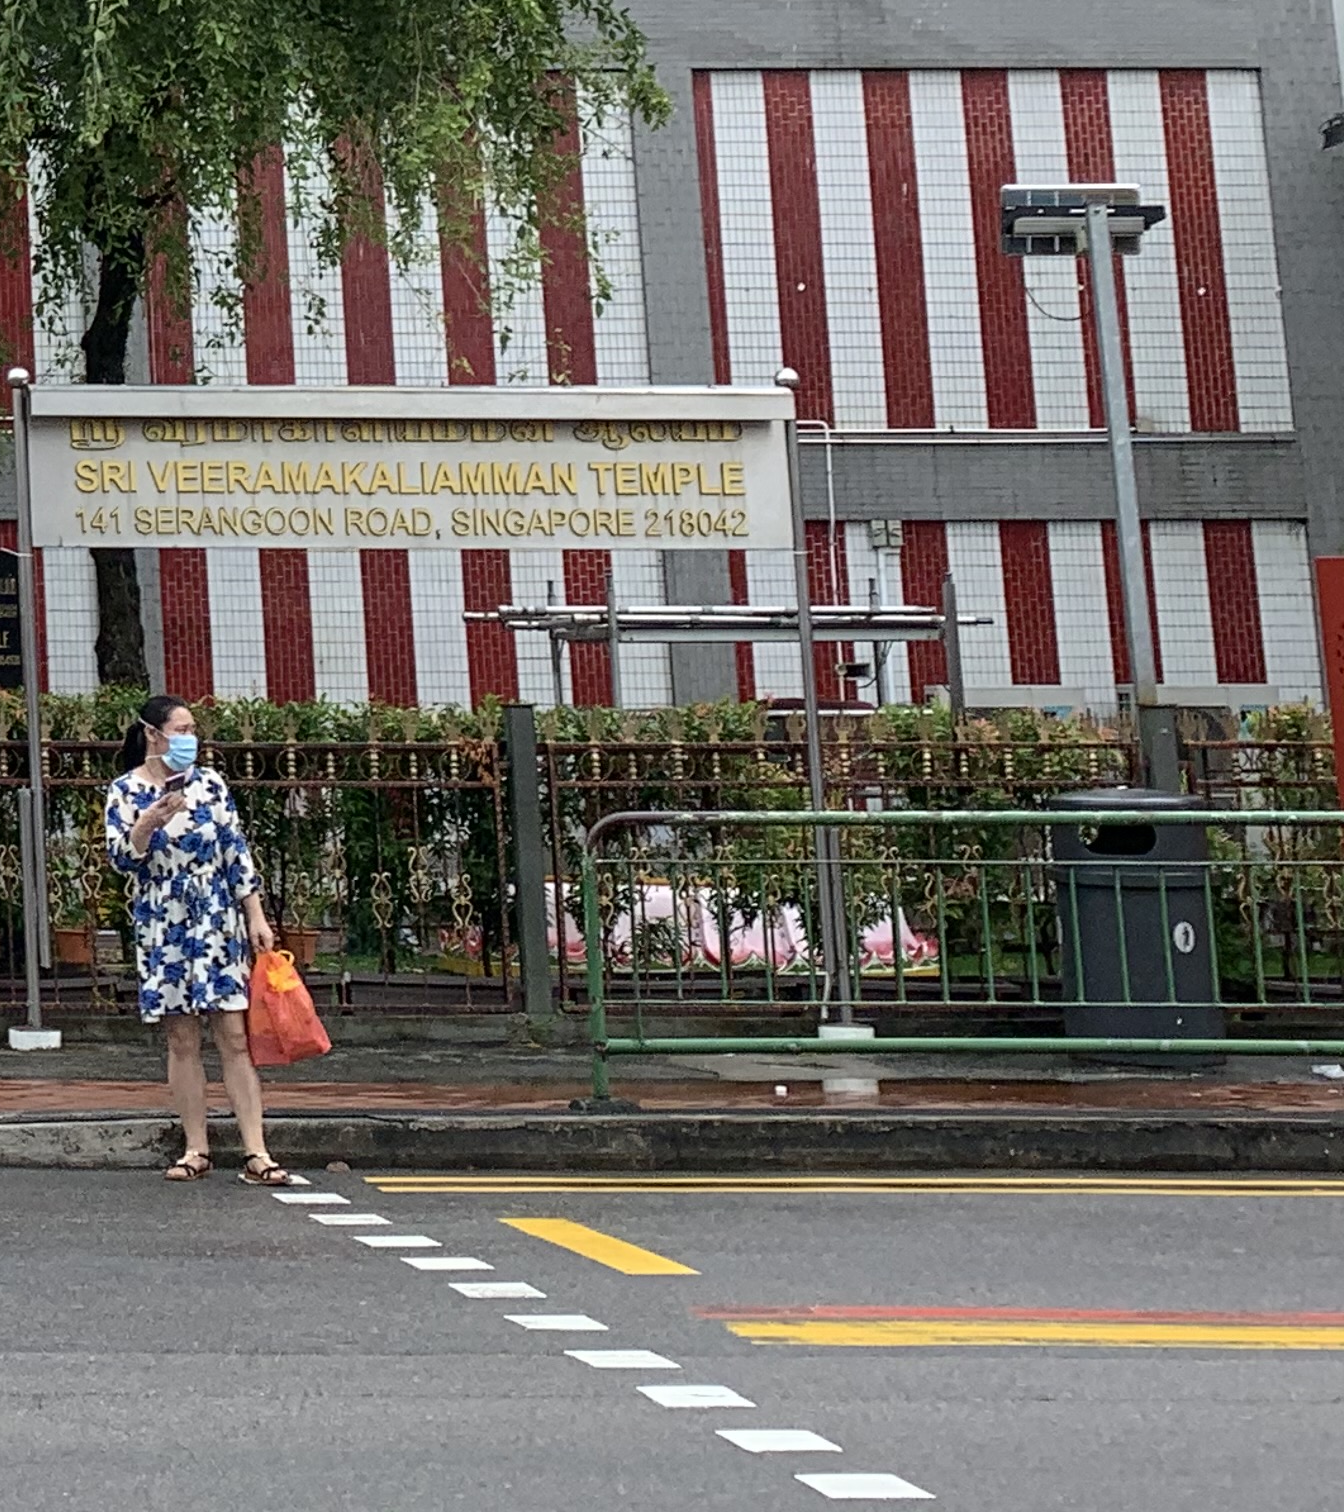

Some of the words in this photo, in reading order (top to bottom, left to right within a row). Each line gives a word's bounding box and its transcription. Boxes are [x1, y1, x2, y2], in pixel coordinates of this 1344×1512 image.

[74, 460, 137, 494] SRI
[147, 460, 578, 496] VEERAMAKALIAMMAN
[588, 461, 747, 496] TEMPLE
[74, 506, 123, 536] 141
[134, 506, 335, 537] SERANGOON
[343, 506, 442, 540] ROAD,
[451, 508, 637, 538] SINGAPORE
[644, 508, 750, 538] 218042
